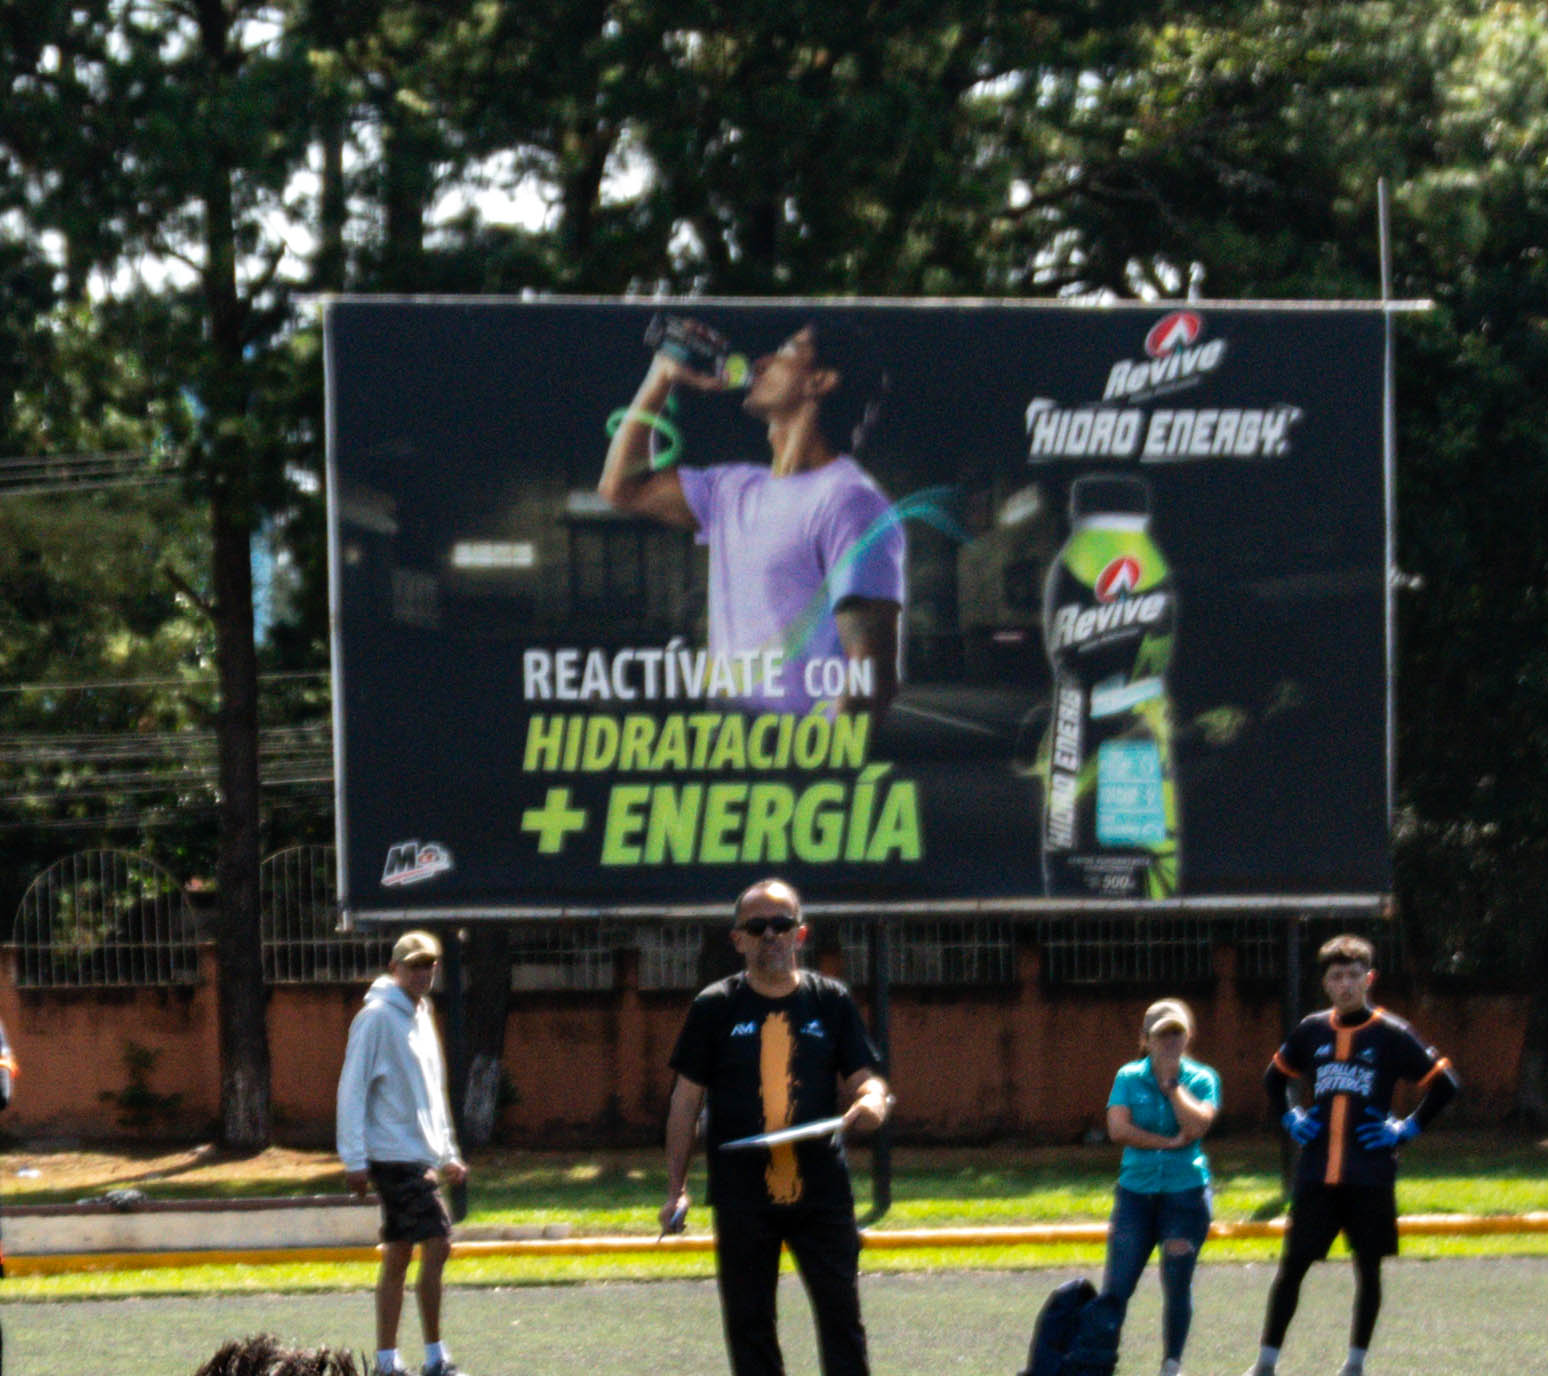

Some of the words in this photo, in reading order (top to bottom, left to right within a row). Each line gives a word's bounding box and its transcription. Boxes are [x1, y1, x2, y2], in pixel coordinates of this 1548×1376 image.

[1103, 338, 1226, 402] Revive
[1029, 407, 1142, 457] HIDRO
[1055, 592, 1168, 650] Revive
[522, 636, 786, 700] REACTÍVATE
[805, 657, 875, 697] CON
[521, 701, 871, 771] HIDRATACIÓN
[521, 788, 588, 853] +
[600, 762, 923, 866] ENERGÍA
